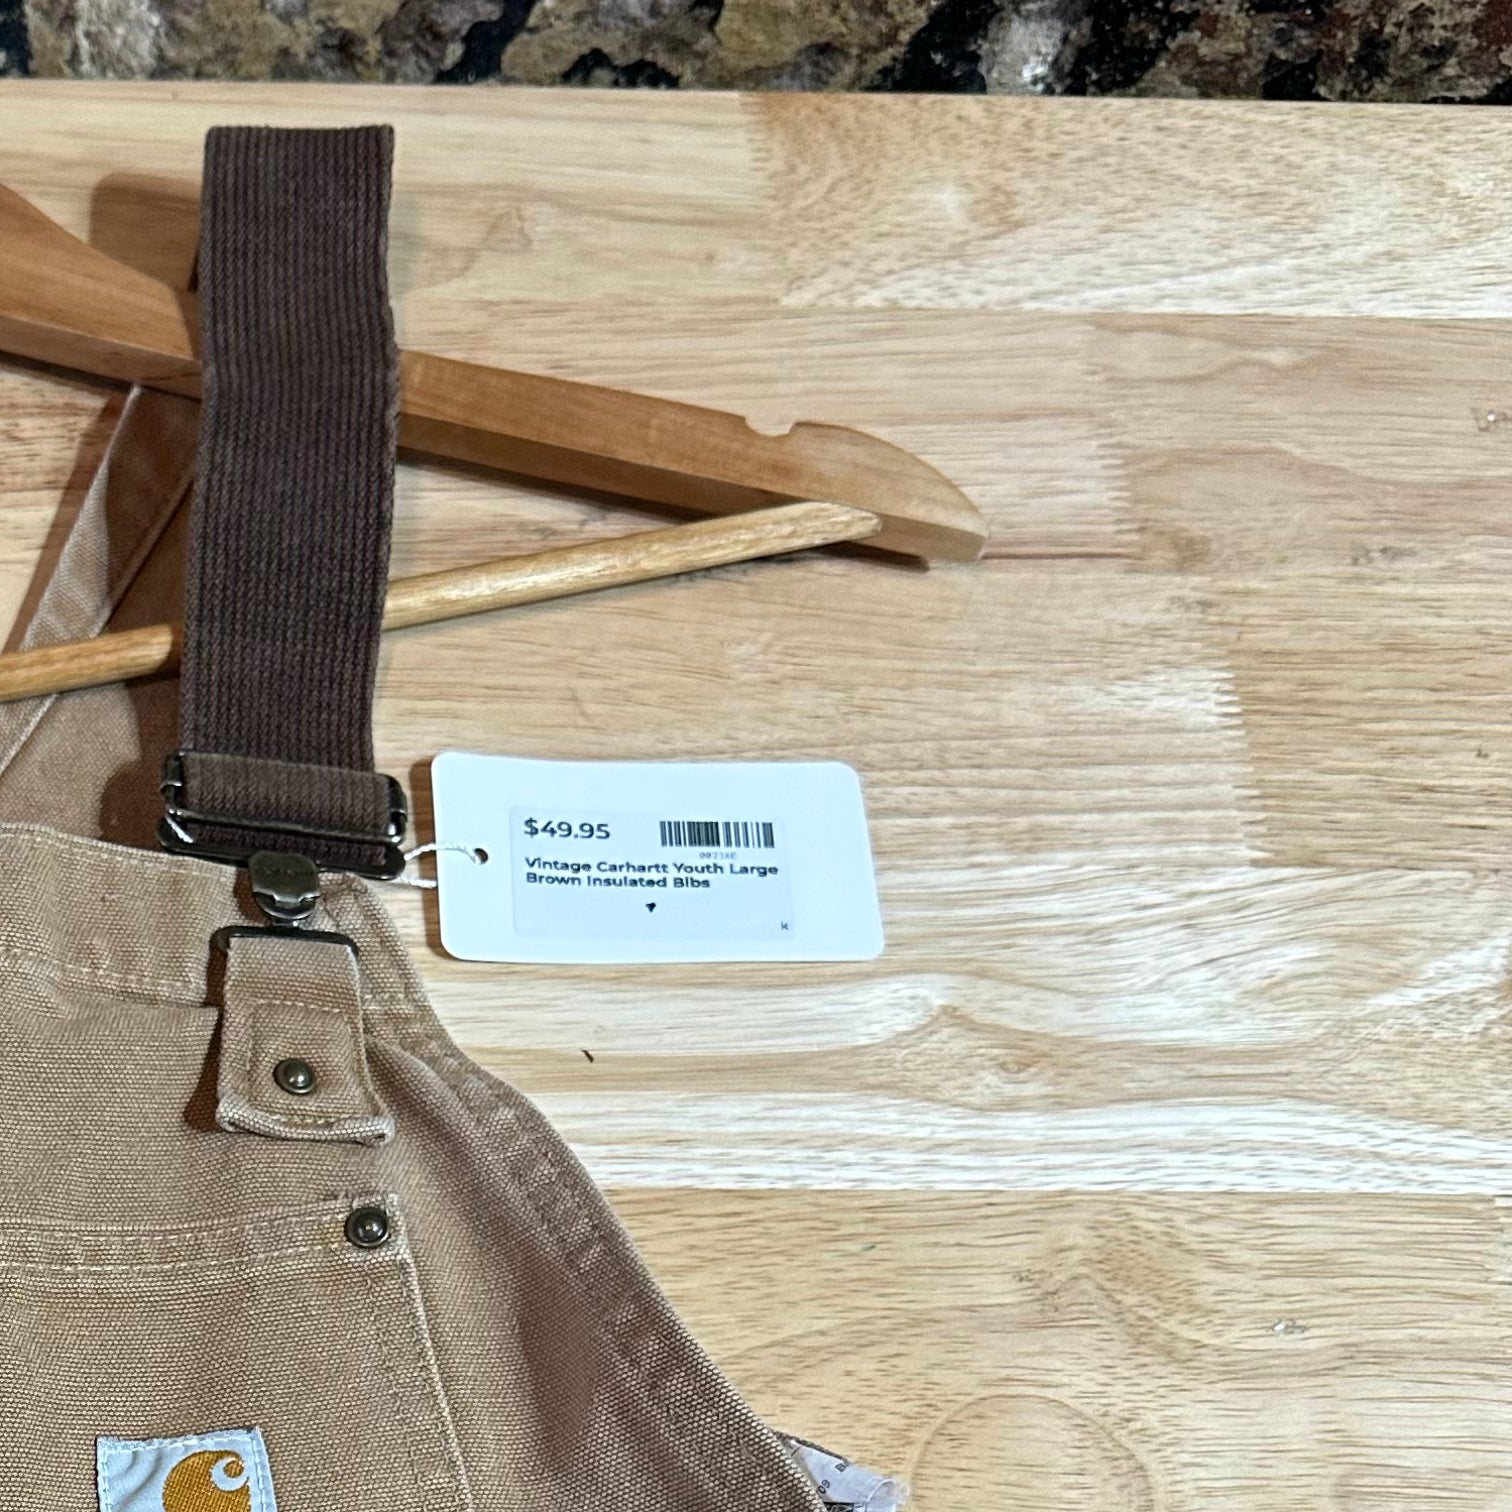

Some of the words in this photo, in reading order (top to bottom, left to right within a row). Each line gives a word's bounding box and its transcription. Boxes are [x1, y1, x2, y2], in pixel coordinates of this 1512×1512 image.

[523, 817, 611, 840] $49.95
[525, 857, 592, 874] Vintage
[596, 861, 669, 874] Carhartt
[672, 863, 725, 875] Youth
[729, 863, 779, 878] Large
[526, 872, 582, 886] Brown
[587, 875, 668, 888] Insulated
[673, 877, 710, 888] Bibs
